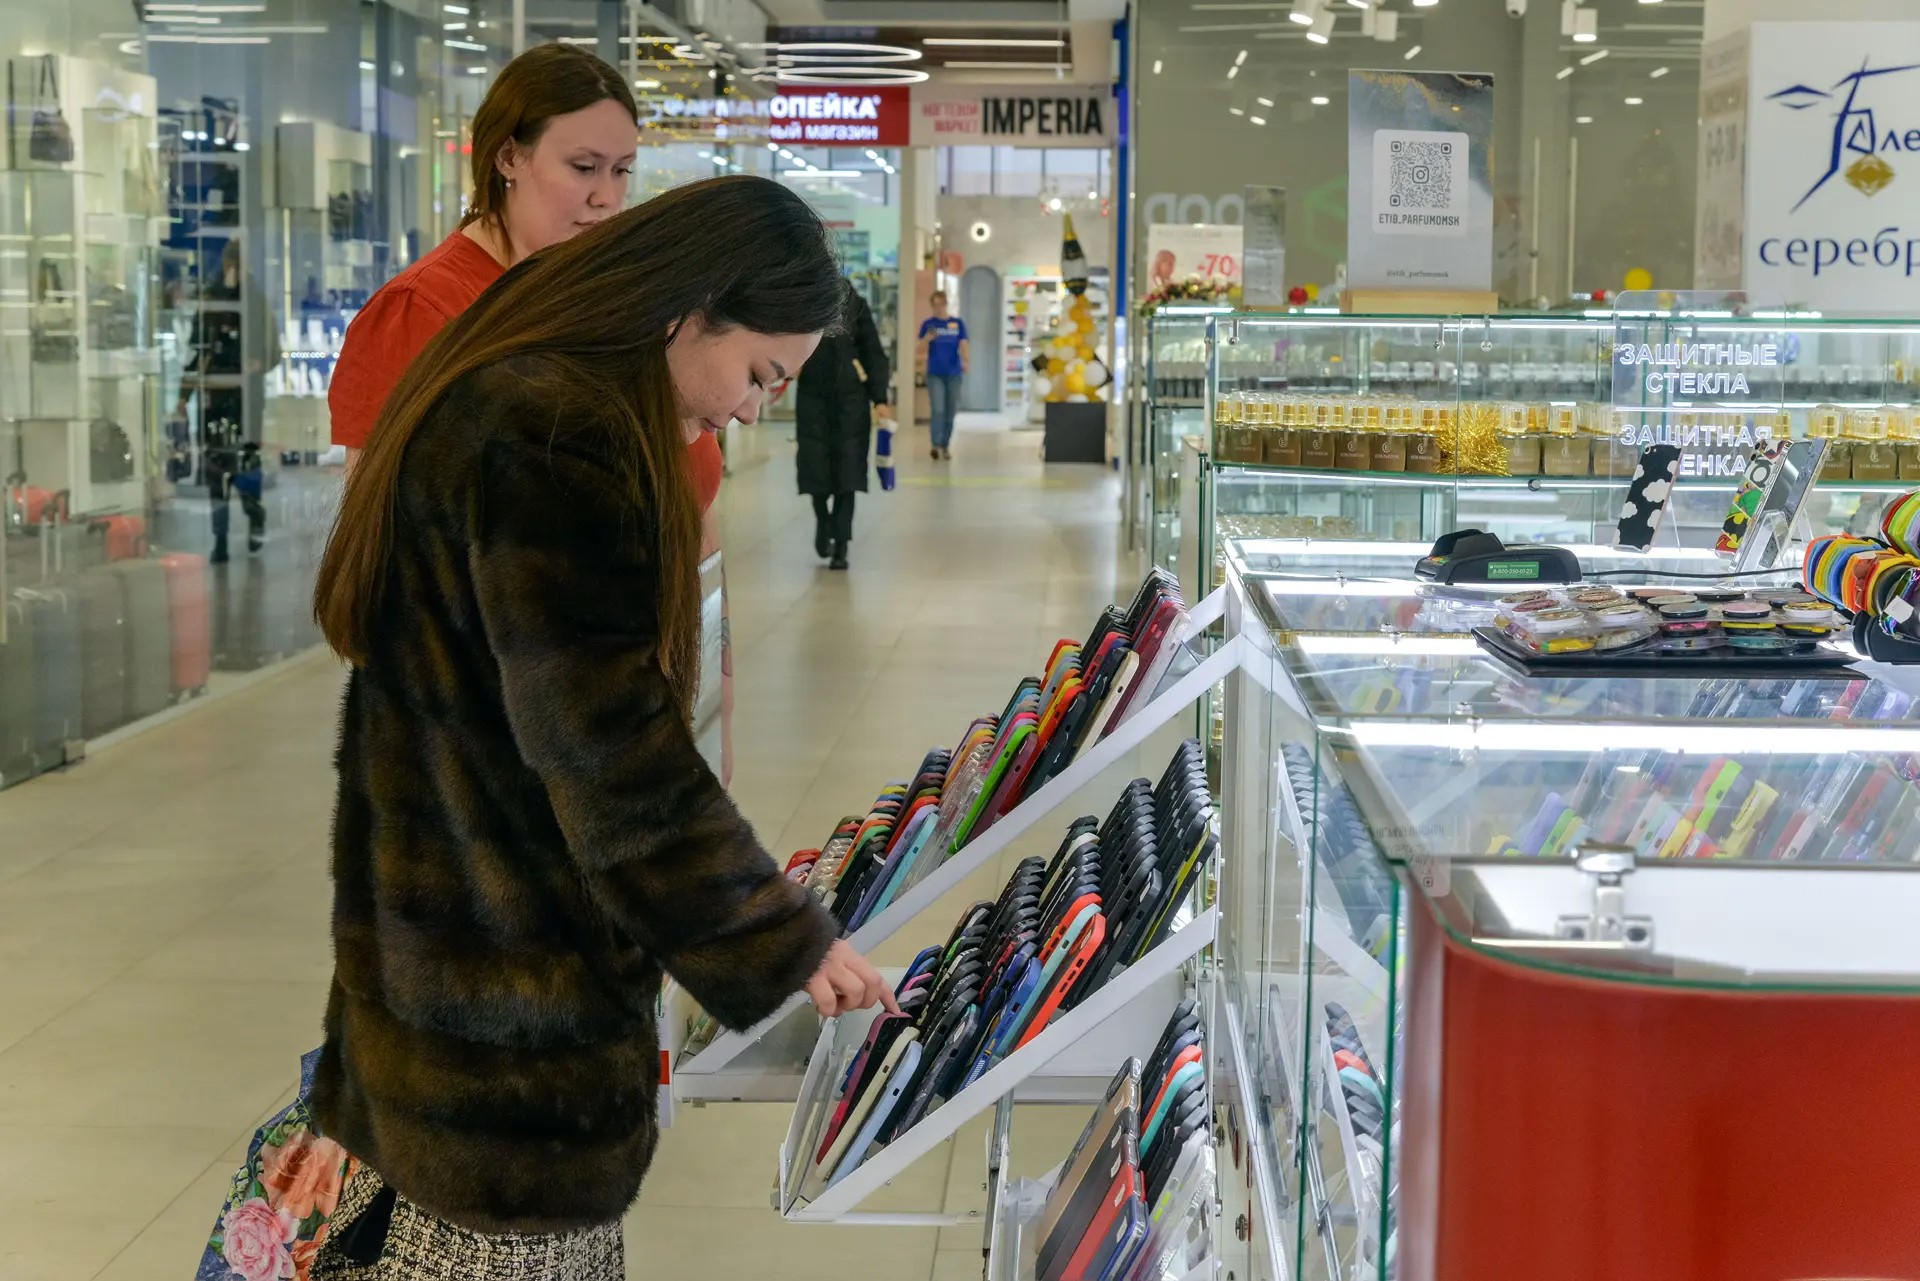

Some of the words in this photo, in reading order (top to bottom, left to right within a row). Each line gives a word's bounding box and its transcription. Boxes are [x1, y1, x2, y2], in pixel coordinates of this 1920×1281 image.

[983, 97, 1103, 135] IMPERIA
[1378, 213, 1460, 226] ETIB_PARFUMOMSK
[1619, 343, 1777, 369] ЗАЩИТНЫЕ
[1646, 372, 1750, 394] СТЕКЛА
[1620, 424, 1772, 448] ЗАЩИТНАЯ
[1679, 453, 1747, 476] ЕНКА
